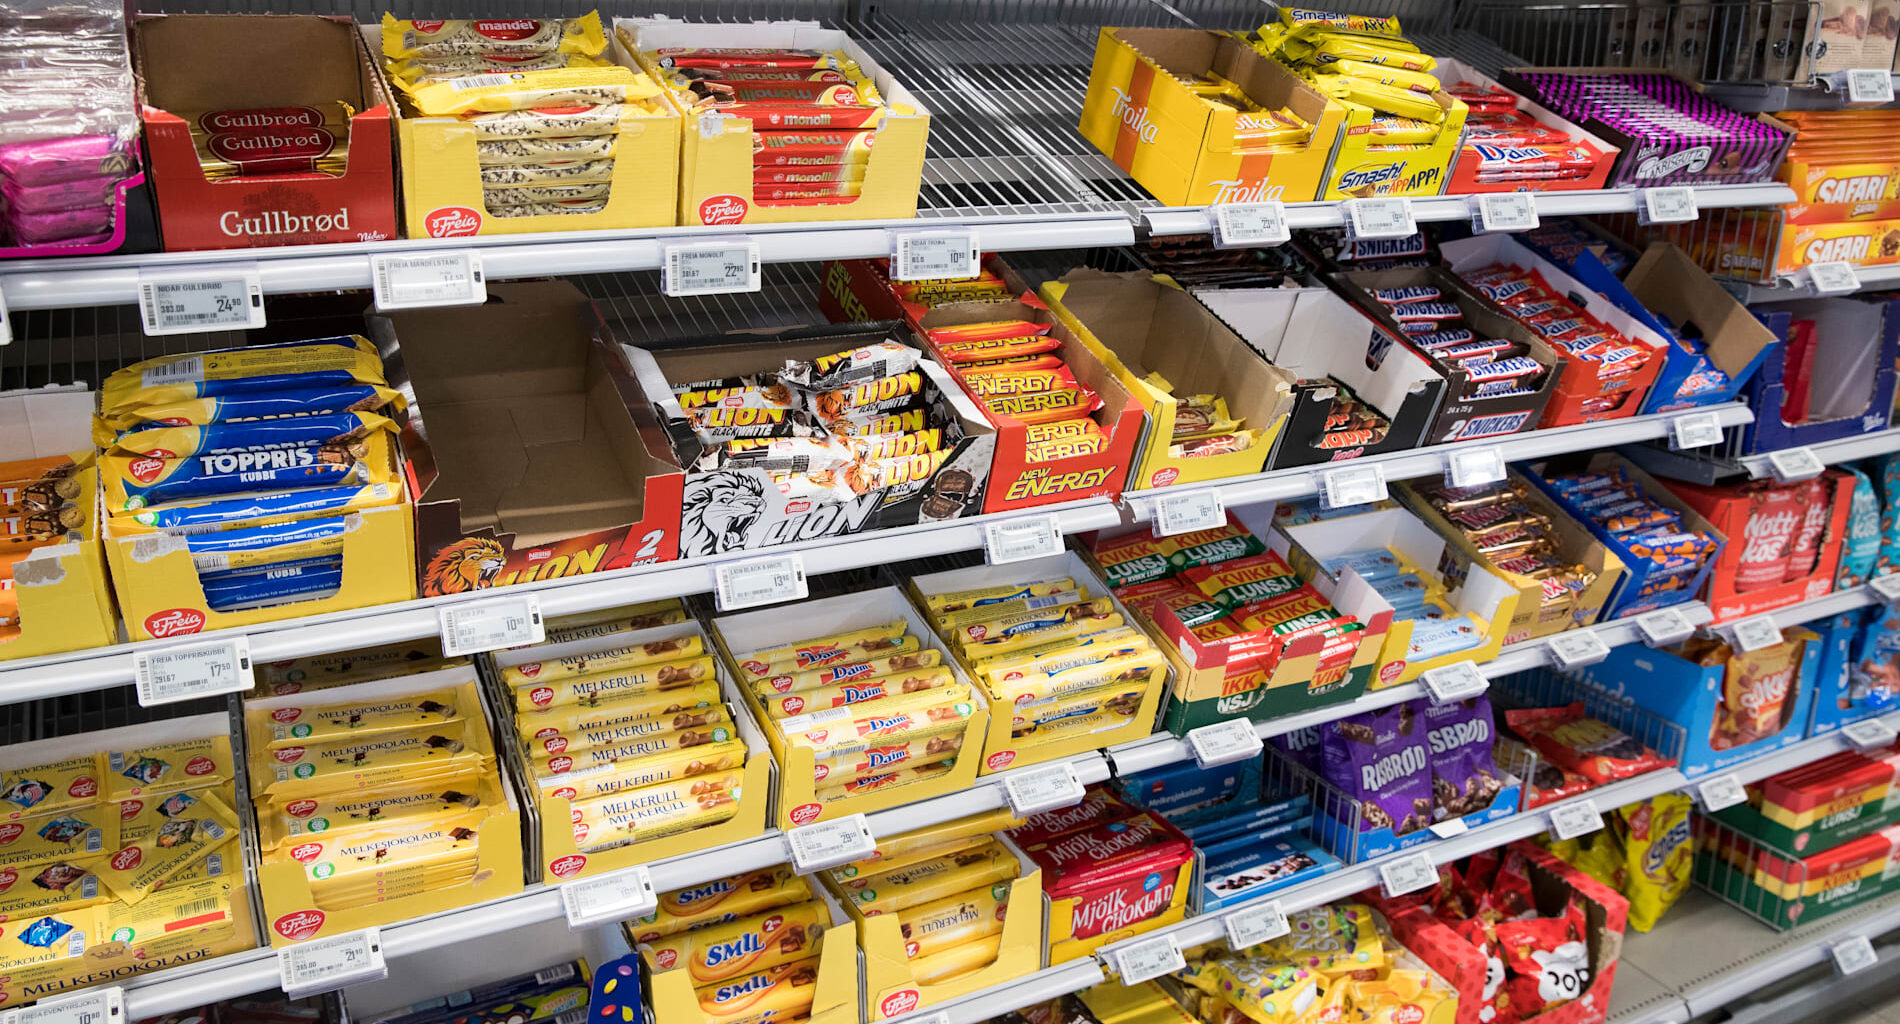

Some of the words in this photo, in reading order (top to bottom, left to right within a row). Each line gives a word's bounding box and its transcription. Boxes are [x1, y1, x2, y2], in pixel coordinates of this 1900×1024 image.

[479, 20, 534, 31] mandel
[1291, 10, 1348, 22] Smash!
[214, 113, 311, 128] Gullbrød
[784, 114, 832, 126] monolit
[1111, 87, 1159, 144] Troika
[222, 133, 321, 150] Gullbrød
[1473, 144, 1549, 164] Daim
[1337, 161, 1407, 190] Smash!
[1817, 176, 1888, 203] SAFARI
[704, 200, 744, 218] Freia
[220, 208, 350, 237] Gullbrød
[432, 212, 478, 231] Freia
[357, 230, 387, 241] Nidar
[1806, 235, 1872, 262] SAFARI
[920, 286, 945, 294] NEW
[1396, 302, 1463, 317] SNICKERS
[966, 373, 993, 381] NEW
[1472, 358, 1537, 376] SNICKERS
[857, 371, 922, 407] LION
[988, 391, 1079, 415] ENERGY
[709, 408, 786, 428] LION
[1441, 420, 1466, 442] 2
[1462, 413, 1529, 437] SNICKERS
[872, 429, 942, 460] LION
[200, 448, 313, 476] TOPPRIS
[240, 470, 276, 483] KUBBE
[1005, 465, 1117, 501] ENERGY
[1019, 467, 1052, 481] NEW
[759, 490, 882, 548] LION
[634, 529, 665, 559] 2
[1174, 526, 1237, 547] KVIKK
[1185, 538, 1247, 560] LUNSJ
[1739, 537, 1783, 563] kos
[266, 568, 302, 580] KUBBE
[1106, 553, 1169, 580] LUNSJ
[1216, 566, 1278, 587] KVIKK
[1229, 577, 1292, 600] LUNSJ
[153, 613, 201, 630] Freia
[1255, 599, 1318, 625] KVIKK
[152, 656, 172, 664] FREIA
[560, 647, 635, 666] MELKERULL
[832, 664, 869, 681] Daim
[573, 674, 648, 695] MELKERULL
[844, 687, 881, 705] Daim
[317, 702, 414, 720] MELKESJOKOLADE
[869, 714, 908, 731] Daim
[587, 722, 665, 745] MELKERULL
[321, 738, 421, 759] MELKESJOKOLADE
[592, 740, 670, 761] MELKERULL
[869, 750, 906, 767] Daim
[1361, 744, 1427, 791] RISBRØD
[596, 770, 673, 793] MELKERULL
[335, 792, 435, 813] MELKESJOKOLADE
[602, 790, 680, 817] MELKERULL
[293, 845, 321, 859] Freia
[340, 830, 443, 856] MELKESJOKOLADE
[136, 841, 208, 892] MELKESJOKOLADE
[678, 880, 735, 904] SMIL
[1073, 887, 1128, 933] Mjölk
[1101, 883, 1174, 934] CHOKLAD
[282, 913, 322, 935] Freia
[706, 932, 765, 967] SMIL
[23, 947, 213, 997] MELKESJOKOLADE
[715, 973, 775, 1002] SMIL
